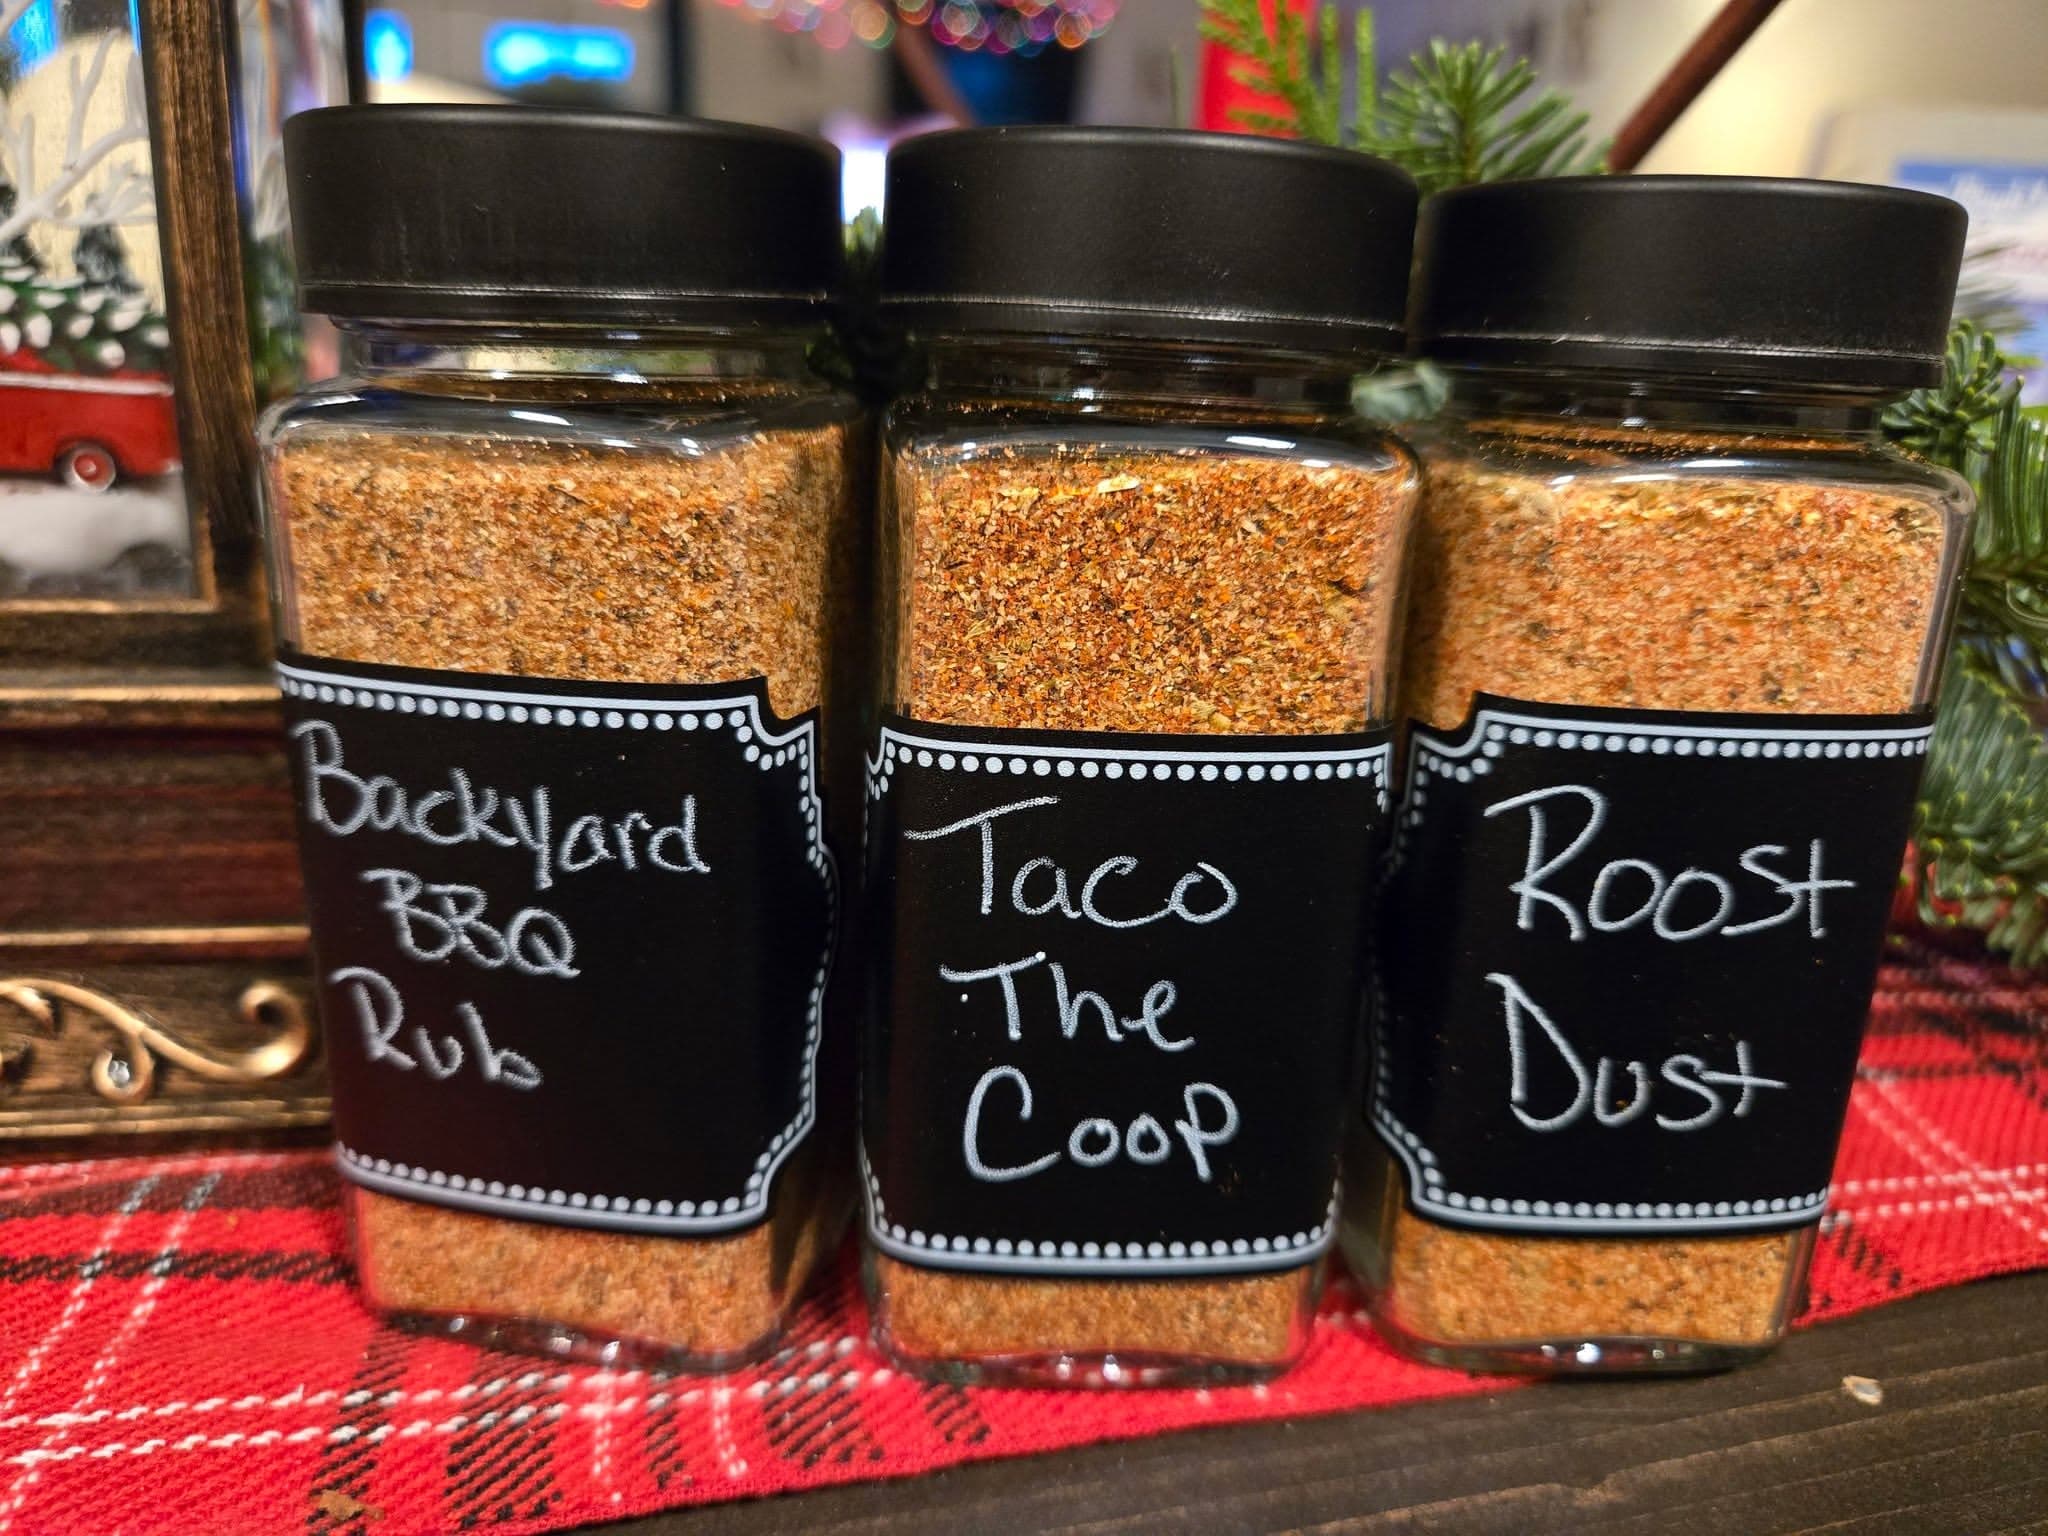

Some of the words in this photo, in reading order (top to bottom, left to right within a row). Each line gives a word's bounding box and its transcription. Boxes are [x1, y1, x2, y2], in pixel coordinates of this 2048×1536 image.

[295, 720, 711, 889] Backyard
[904, 796, 1238, 928] Taco
[1484, 784, 1857, 941] Roost
[361, 869, 581, 979] BBQ
[329, 967, 543, 1090] Rub
[939, 951, 1195, 1051] The
[1485, 972, 1790, 1132] Dust
[963, 1065, 1240, 1183] Coop
